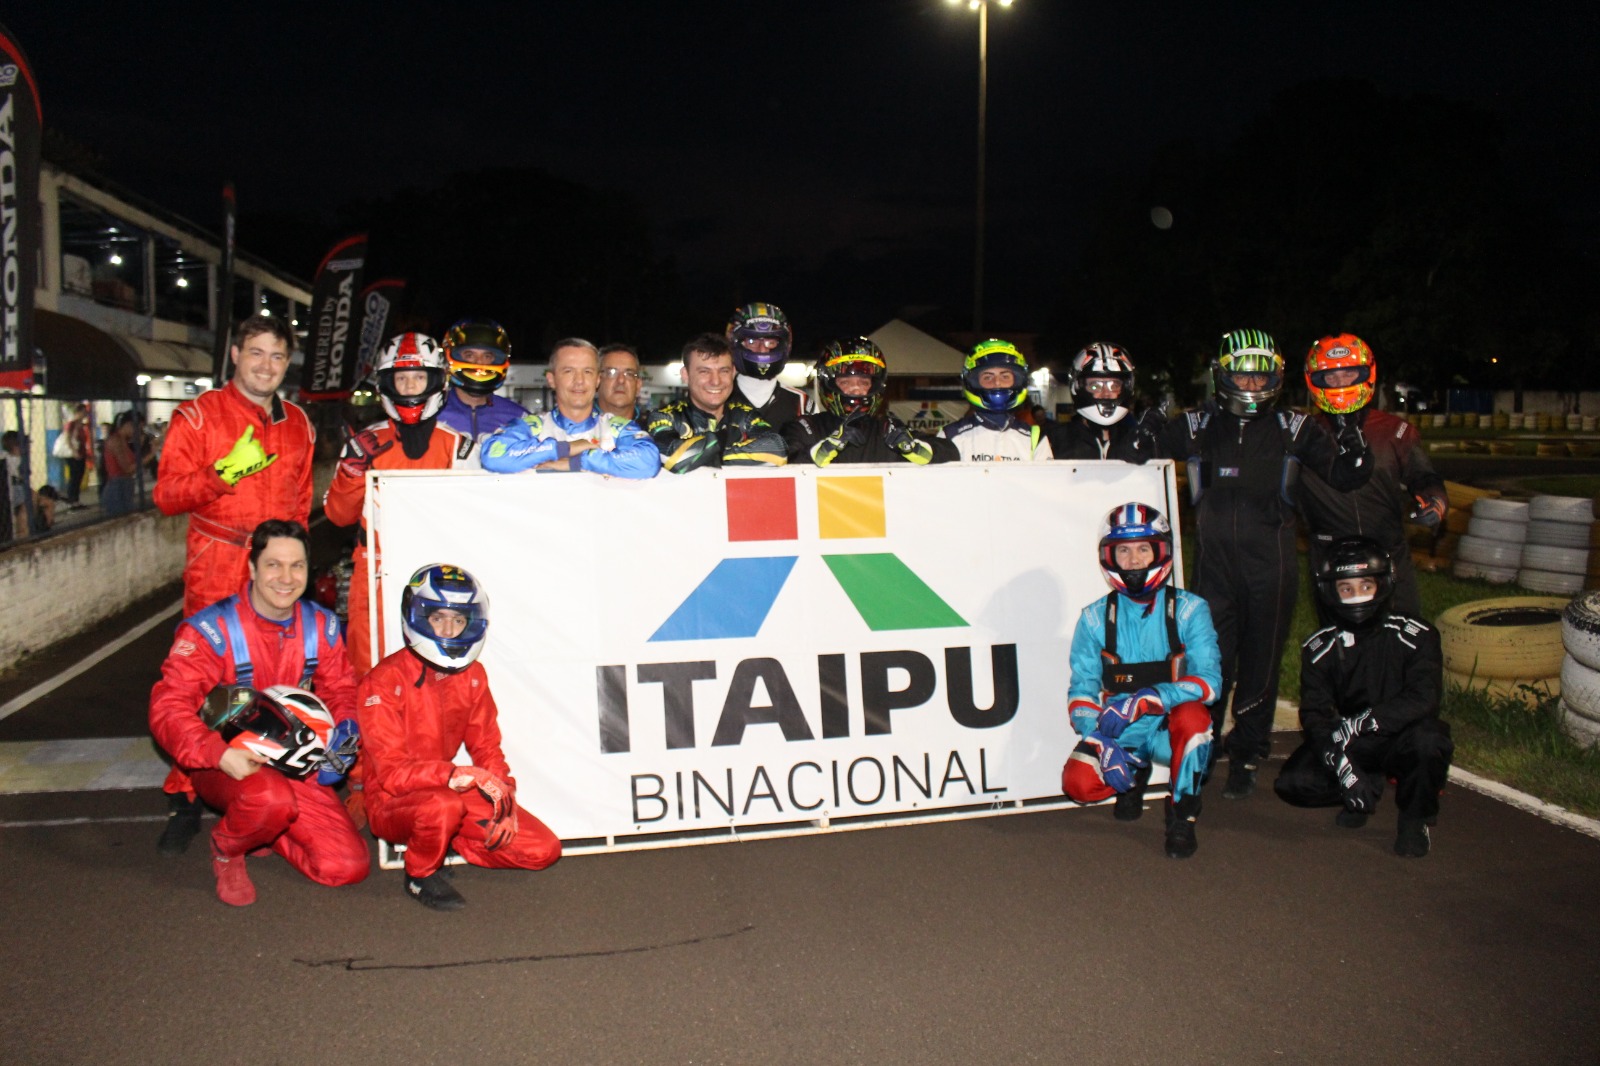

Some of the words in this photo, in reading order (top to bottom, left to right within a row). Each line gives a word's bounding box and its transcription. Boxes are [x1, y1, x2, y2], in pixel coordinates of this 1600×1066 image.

[0, 93, 18, 363] HONDA
[321, 296, 338, 312] by
[325, 271, 354, 391] HONDA
[311, 315, 332, 390] POWERED
[596, 643, 1020, 755] ITAIPU
[1114, 674, 1134, 683] TF5
[630, 748, 1008, 825] BINACIONAL
